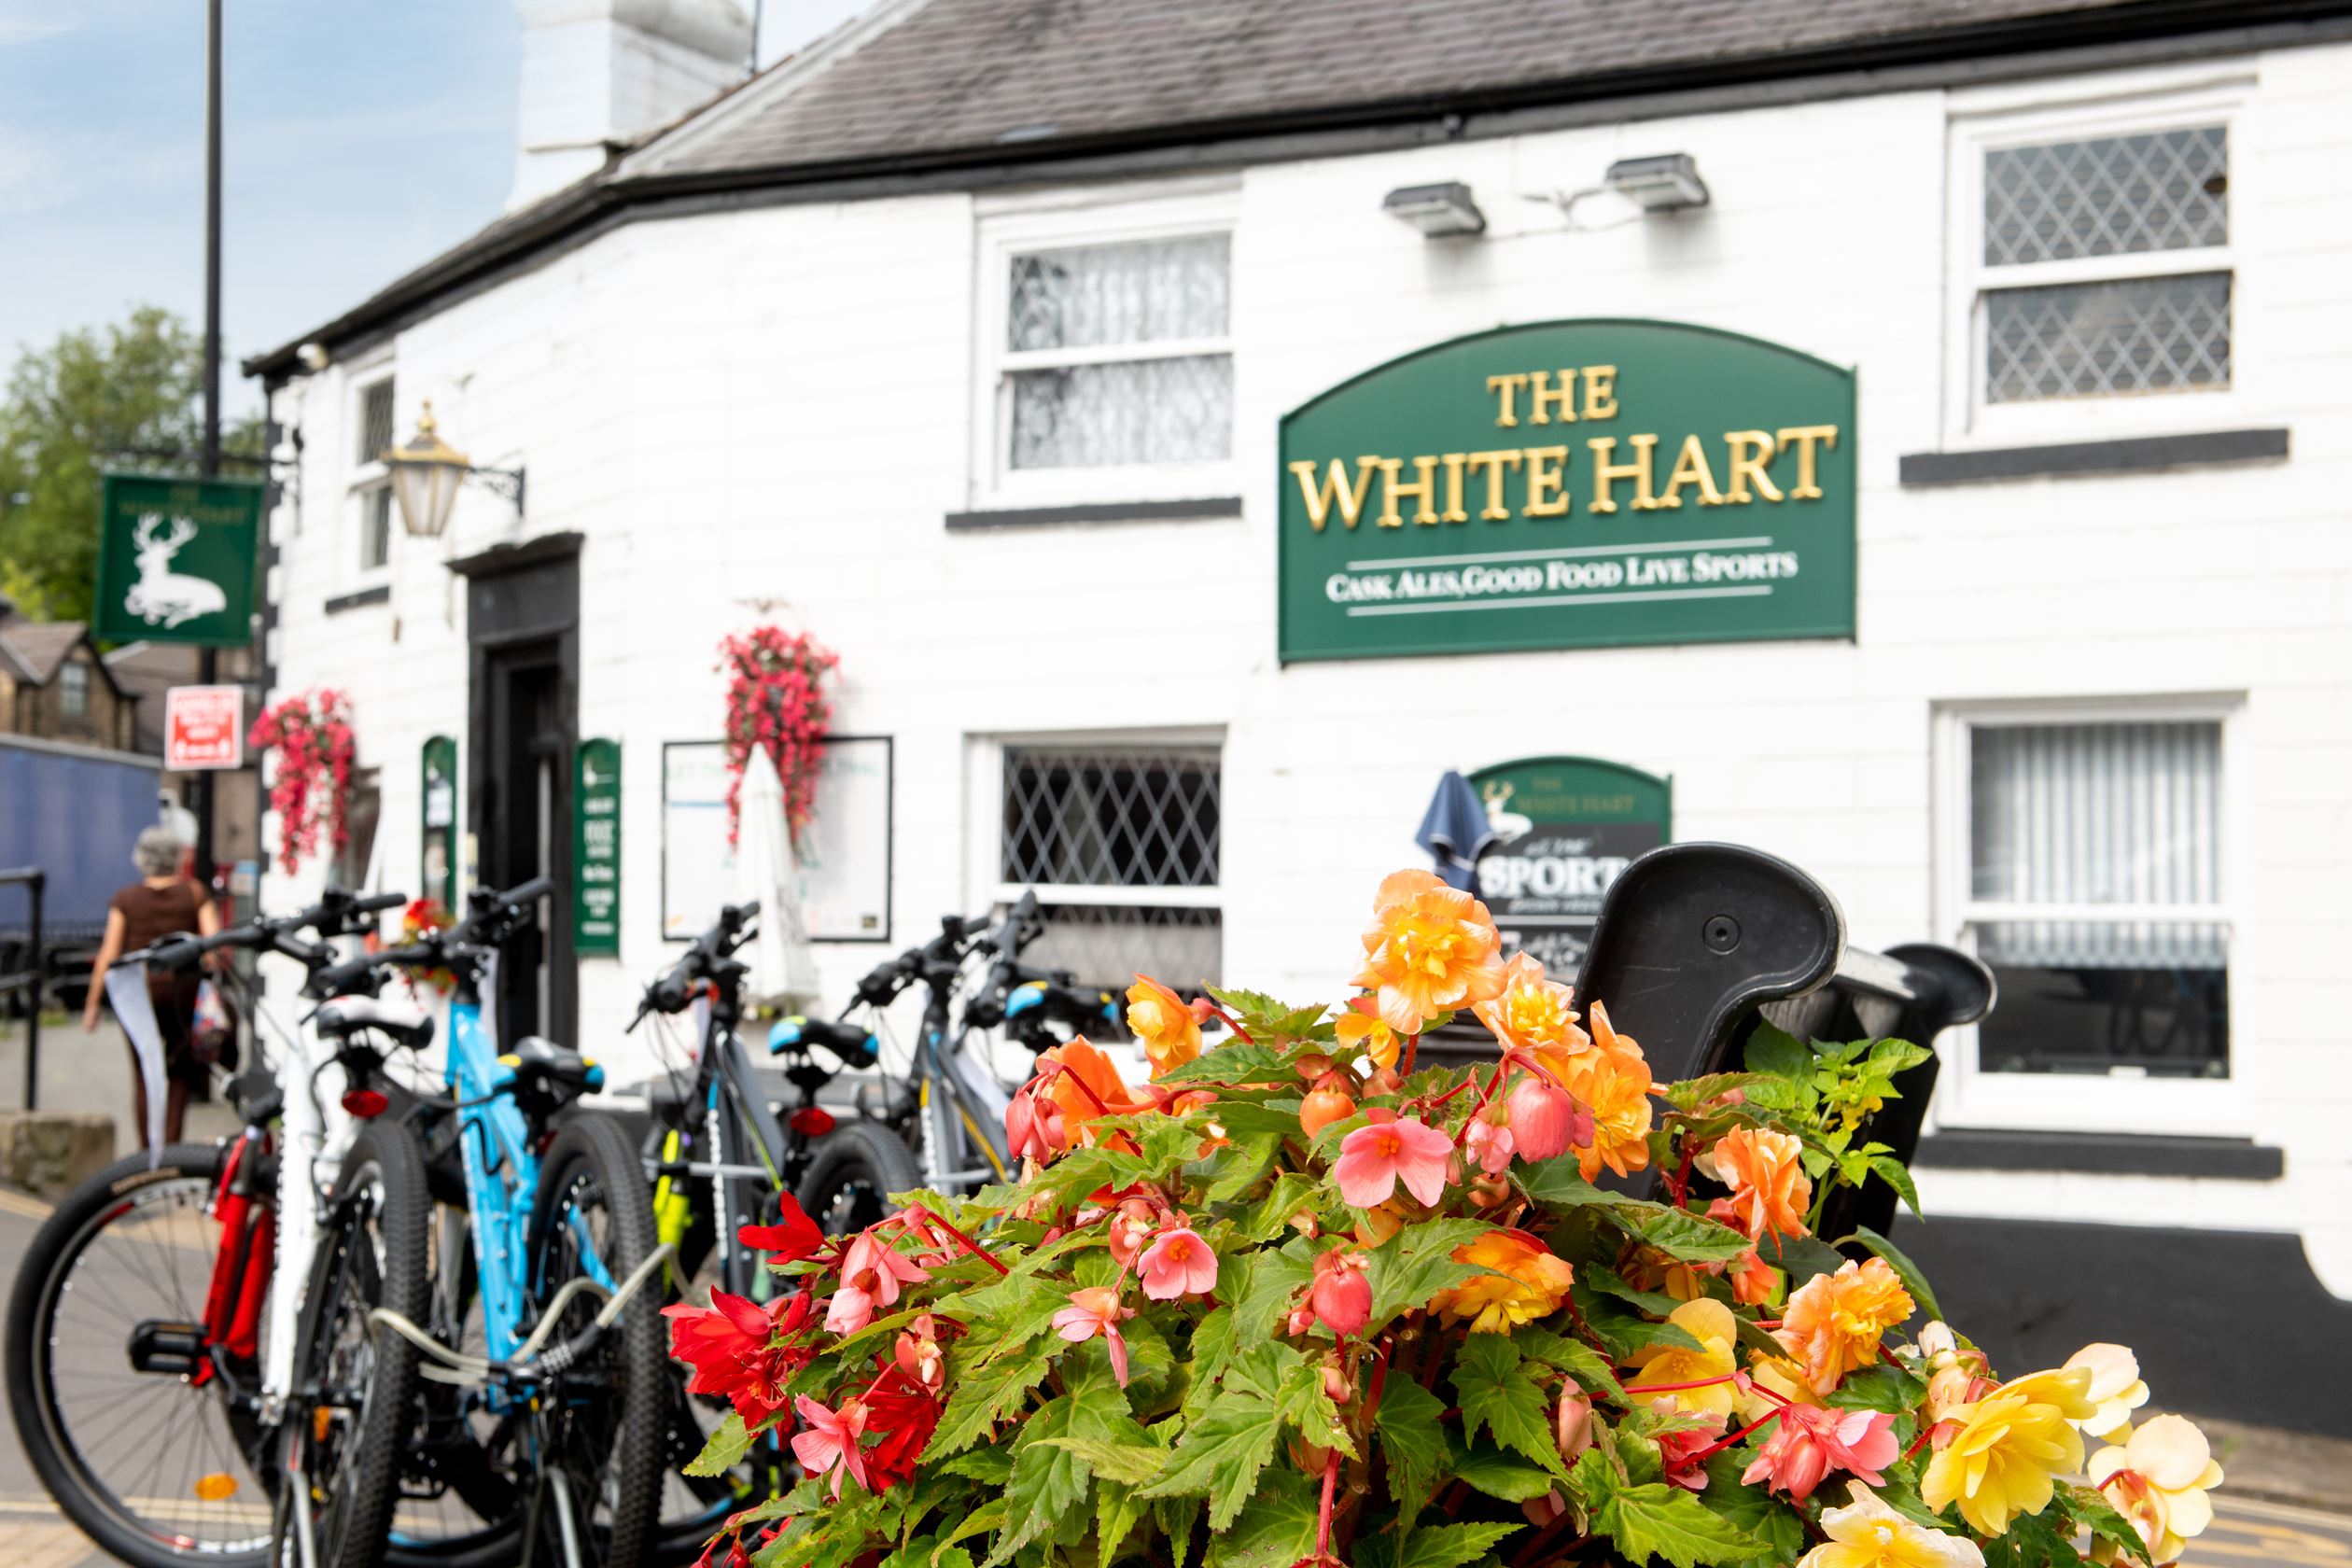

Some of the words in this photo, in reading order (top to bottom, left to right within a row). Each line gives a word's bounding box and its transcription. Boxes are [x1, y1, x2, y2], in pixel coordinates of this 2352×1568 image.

[1485, 365, 1619, 427] THE
[1289, 445, 1570, 530] WHITE
[1589, 425, 1837, 512] HART
[1325, 572, 1393, 602] CASK
[1546, 561, 1623, 590] FOOD
[1626, 557, 1690, 586] LIVE
[1691, 553, 1799, 582] SPORTS
